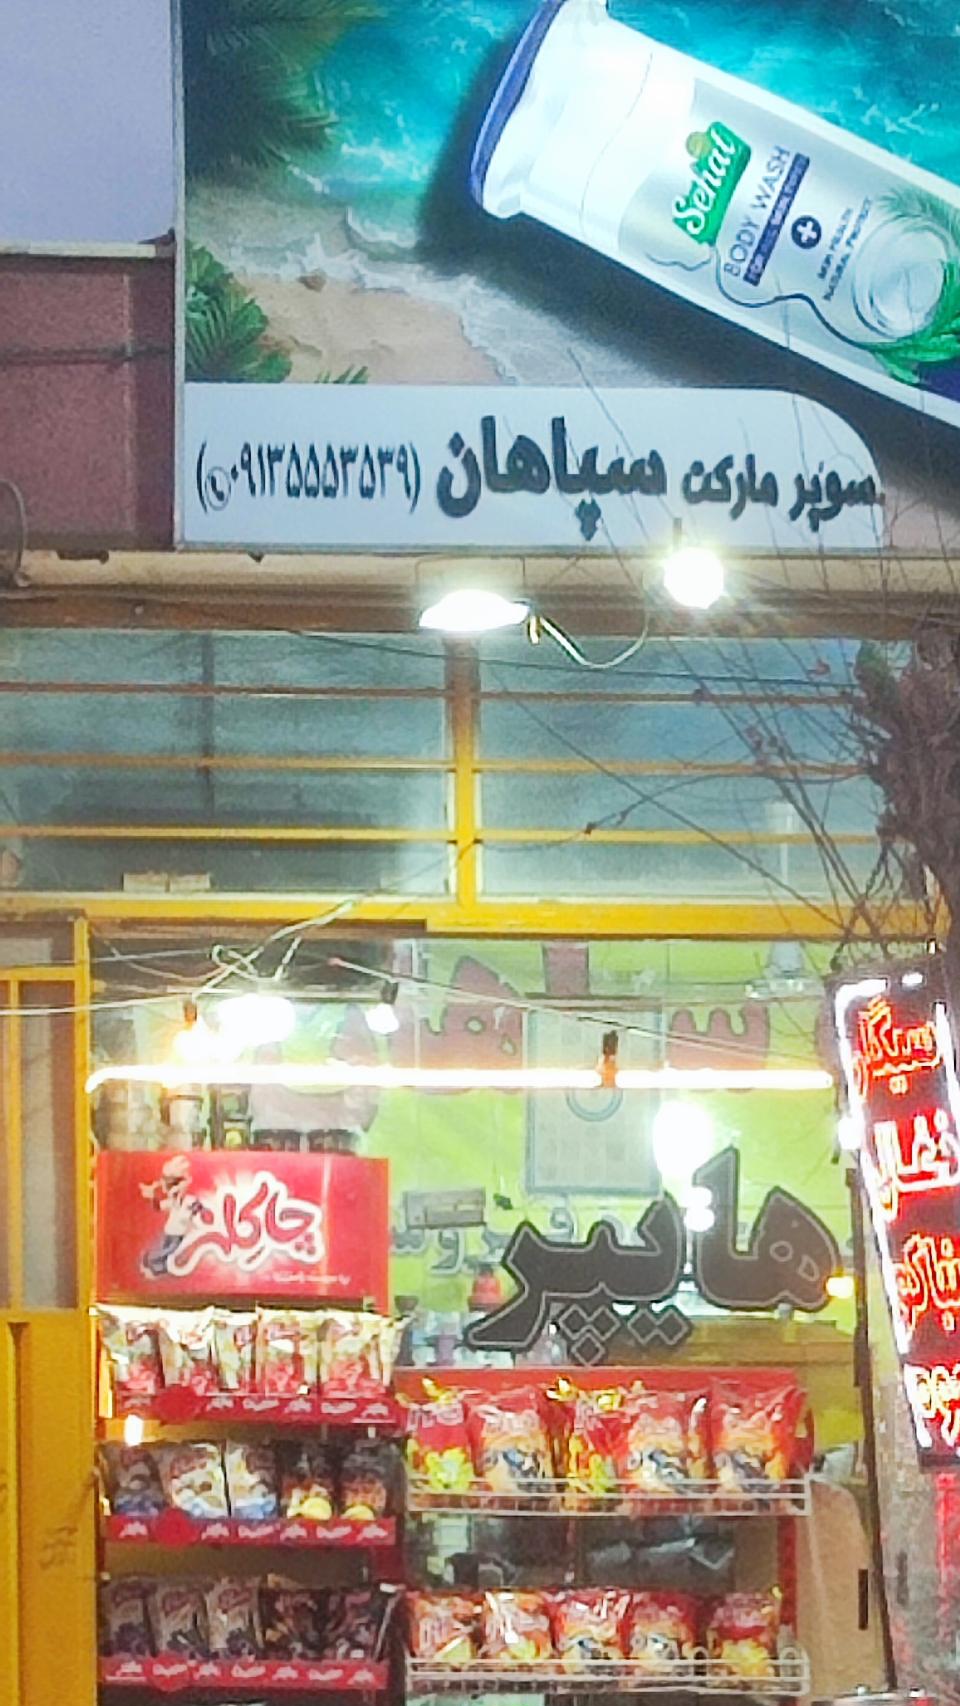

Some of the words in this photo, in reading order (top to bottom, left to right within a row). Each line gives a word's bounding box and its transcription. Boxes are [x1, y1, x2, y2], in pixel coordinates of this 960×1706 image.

[723, 217, 759, 277] BODY
[751, 145, 791, 210] WASH
[436, 415, 667, 541] سپاهان
[682, 453, 778, 521] مارکت
[789, 468, 884, 532] سوپر
[462, 1146, 840, 1365] هایپر
